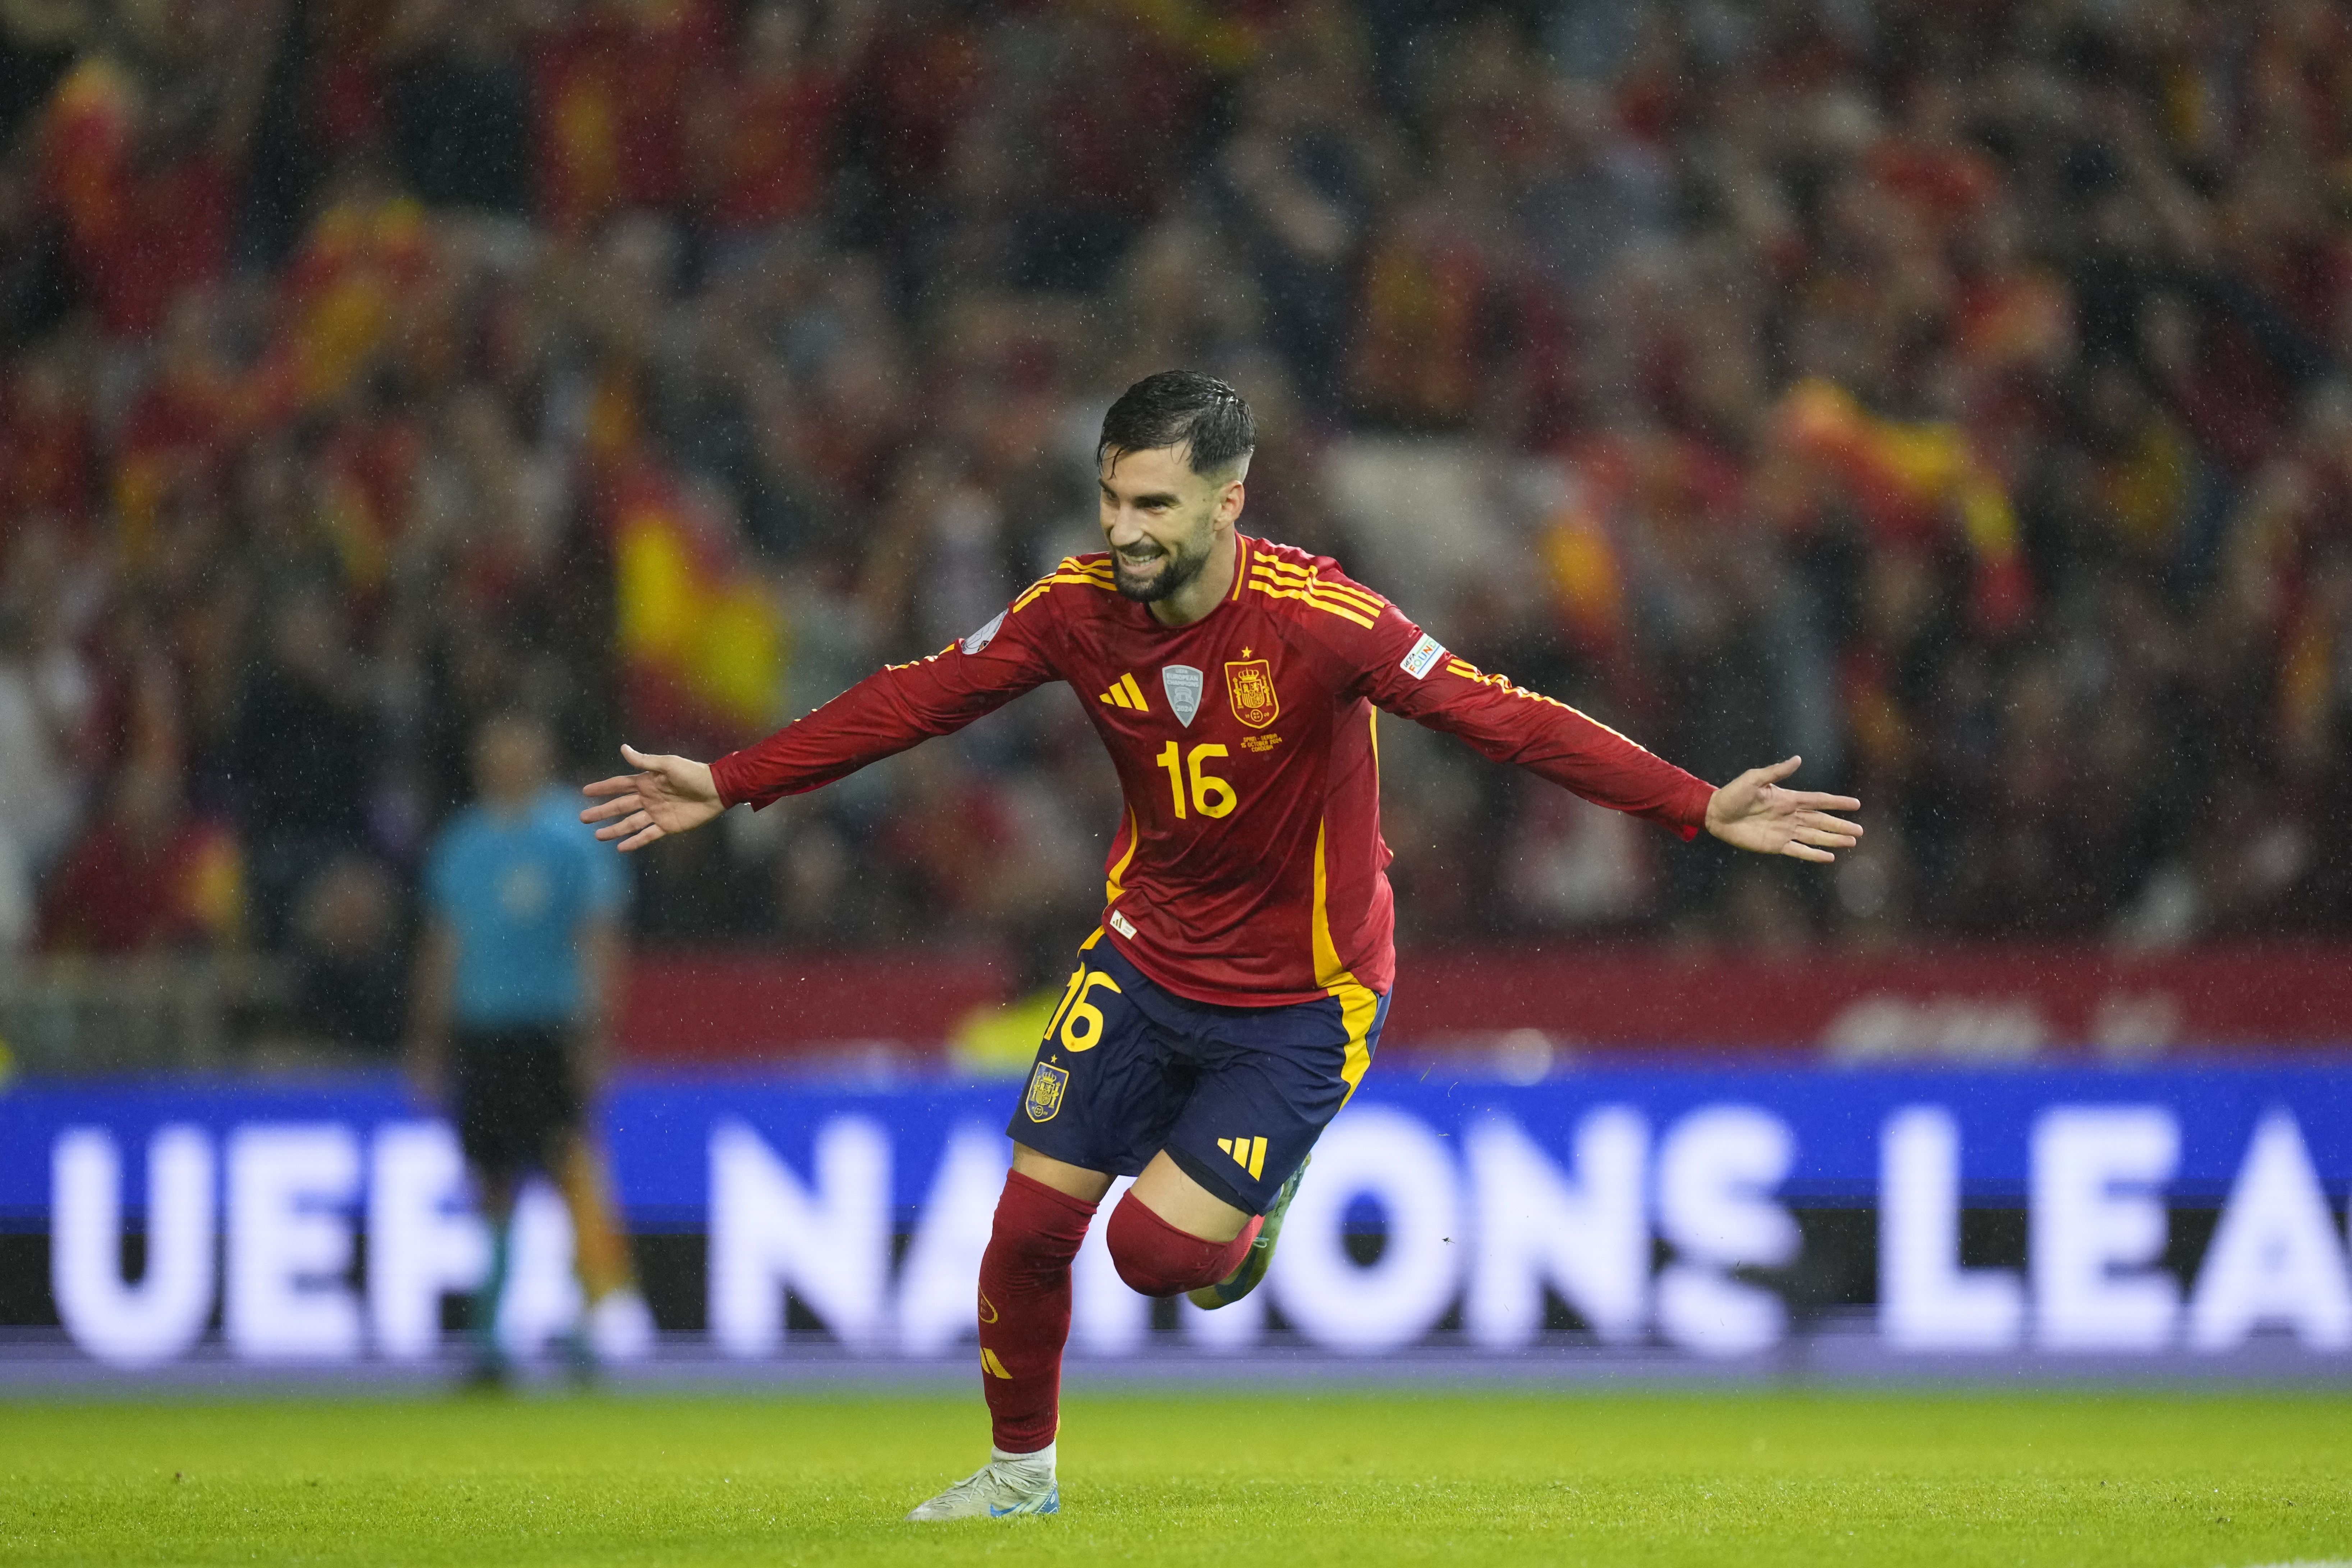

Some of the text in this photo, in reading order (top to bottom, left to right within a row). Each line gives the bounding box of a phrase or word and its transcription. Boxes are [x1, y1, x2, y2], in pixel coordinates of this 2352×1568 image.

[1166, 673, 1198, 681] EUROPEAN
[1167, 679, 1199, 687] CHAMPIONS
[1404, 653, 1417, 668] UEFA
[1156, 740, 1237, 820] 16
[1044, 961, 1122, 1053] 16
[52, 1122, 647, 1366] UEFA
[1880, 1102, 2352, 1350] LEA
